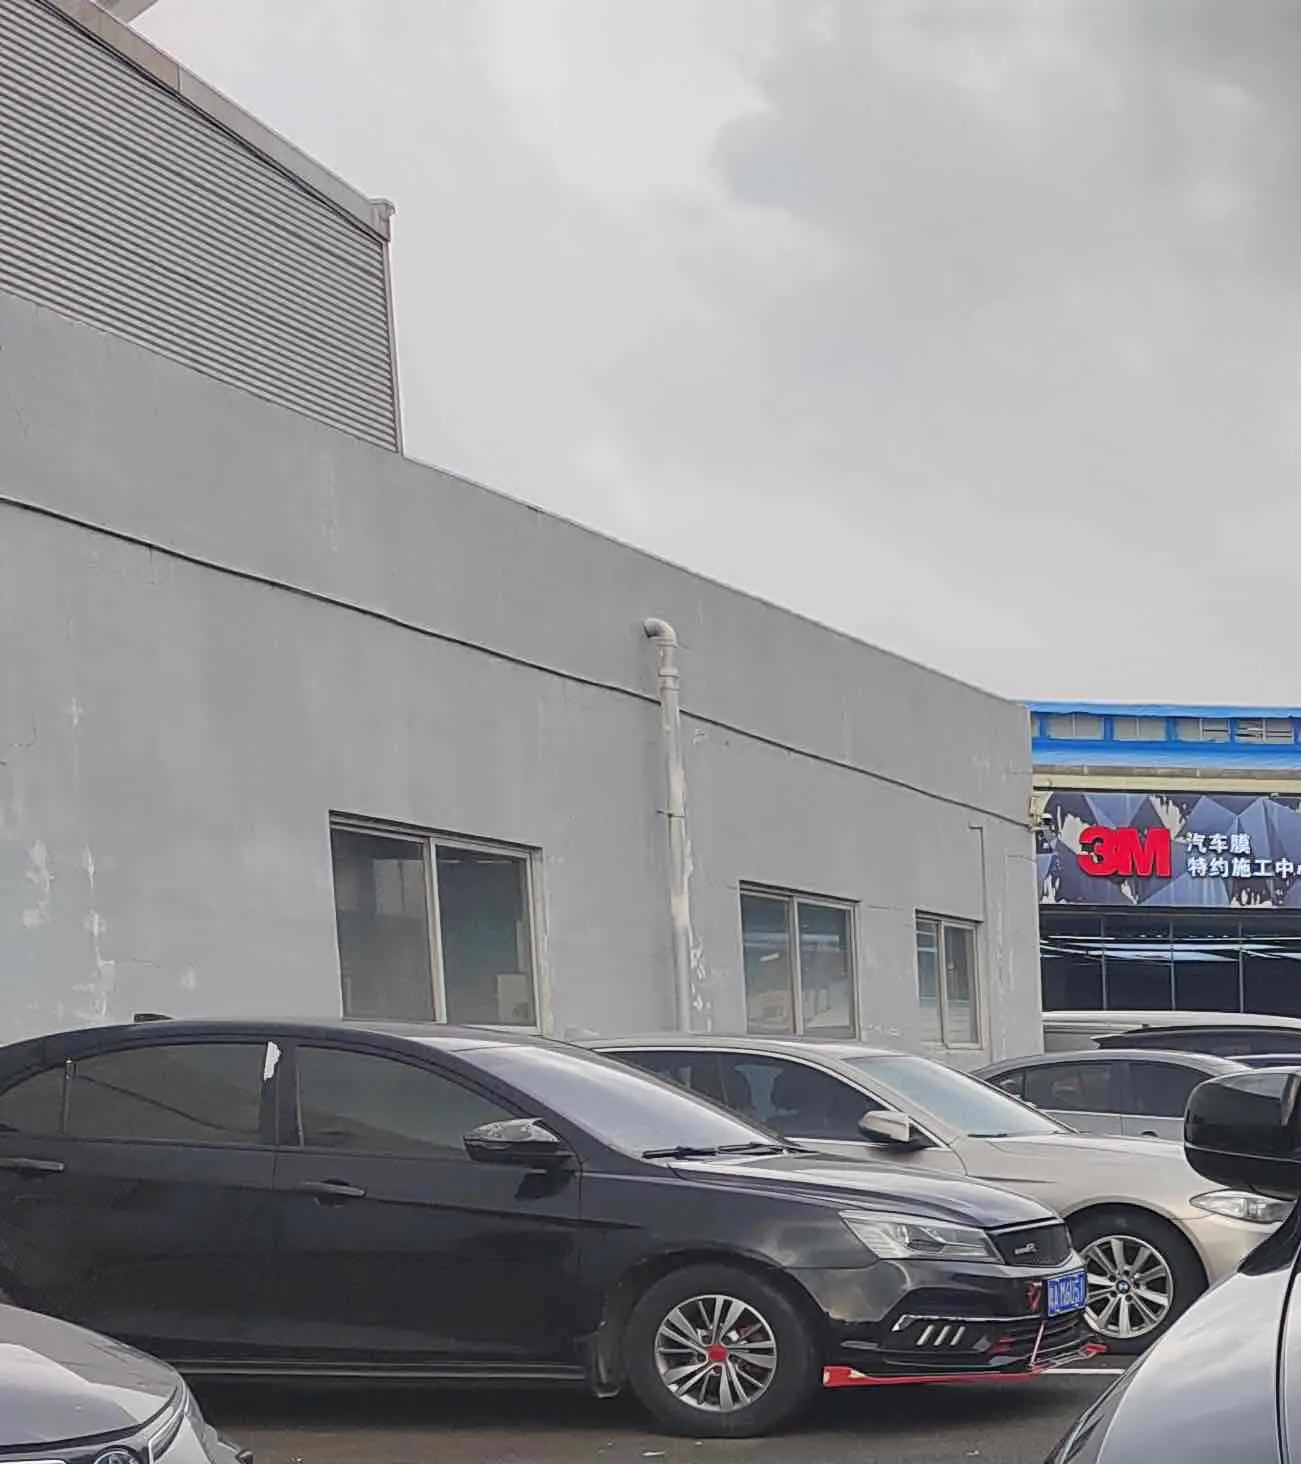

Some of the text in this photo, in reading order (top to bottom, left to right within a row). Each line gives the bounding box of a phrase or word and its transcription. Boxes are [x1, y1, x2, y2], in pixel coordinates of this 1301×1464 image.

[1077, 826, 1172, 877] 3M
[1187, 832, 1251, 854] 汽车膜
